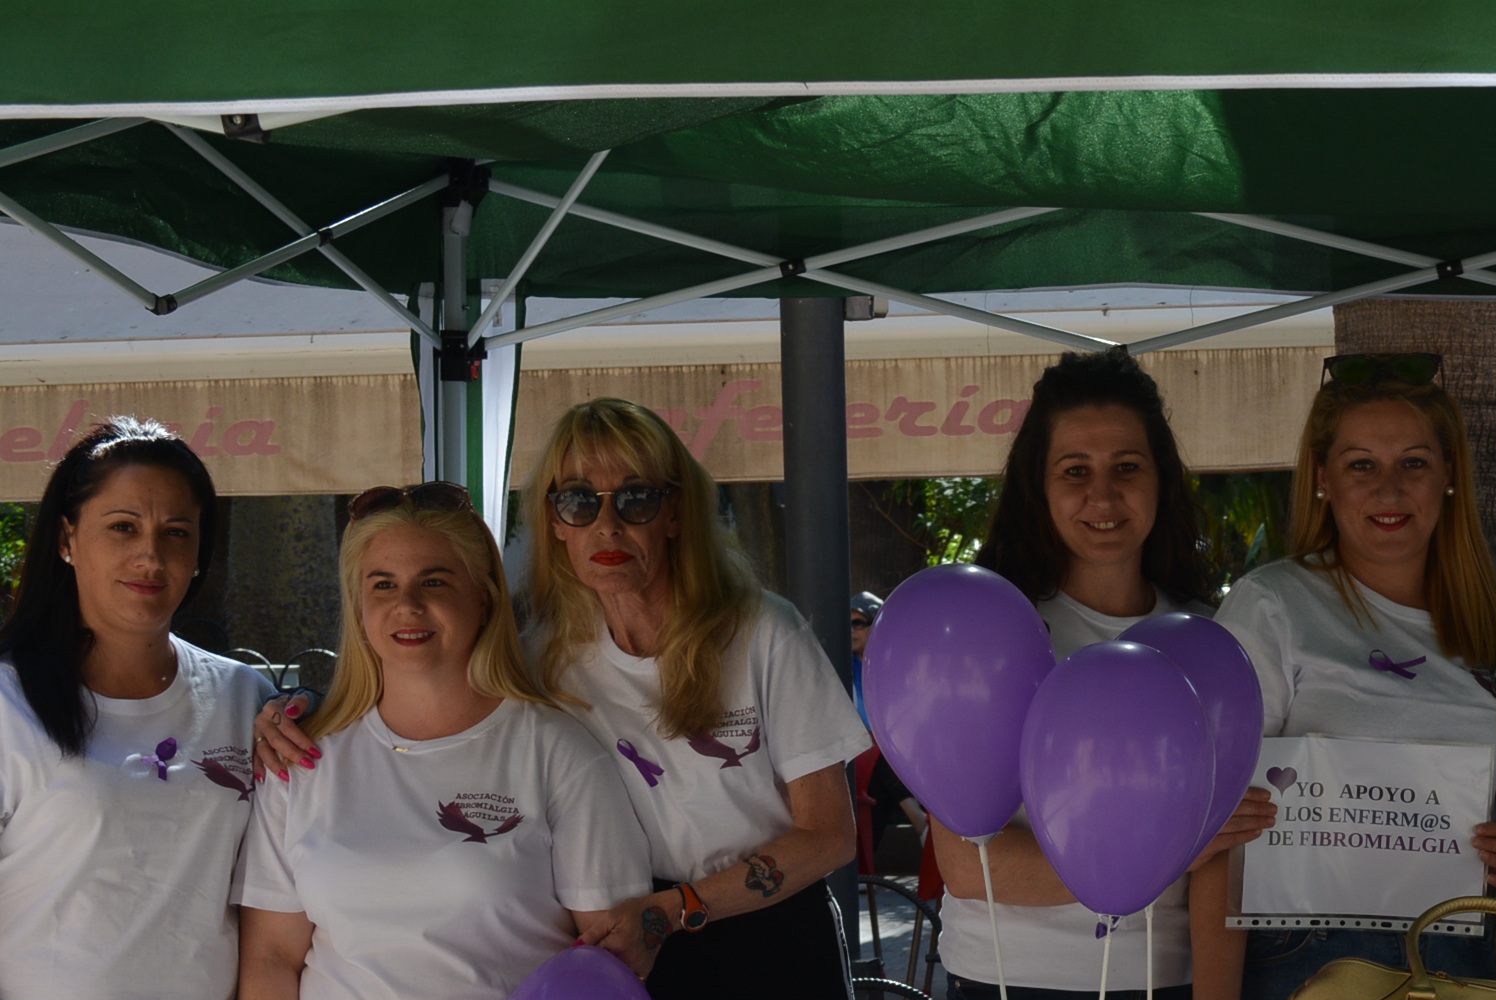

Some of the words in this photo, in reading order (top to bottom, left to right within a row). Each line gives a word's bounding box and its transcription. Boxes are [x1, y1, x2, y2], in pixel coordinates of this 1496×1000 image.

[455, 793, 515, 804] ASOCIACIÓN
[1295, 781, 1324, 798] YO
[1339, 783, 1416, 804] APOYO
[1425, 789, 1441, 806] A
[1285, 806, 1323, 822] LOS
[1328, 807, 1451, 832] ENFERM@S
[1267, 830, 1294, 846] DE
[1299, 831, 1461, 855] FIBROMIALGIA
